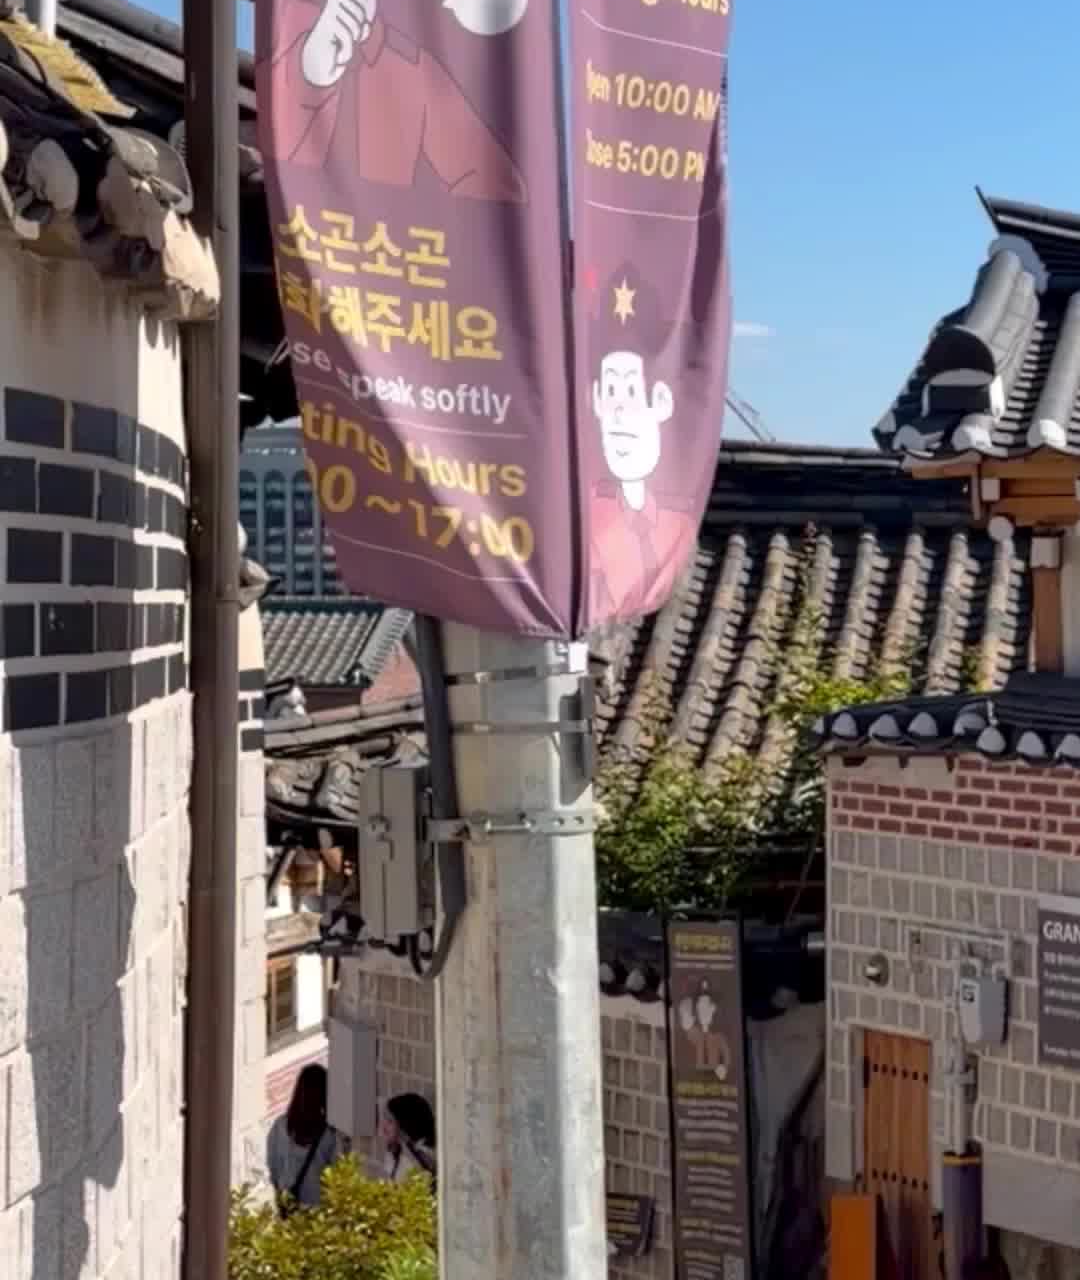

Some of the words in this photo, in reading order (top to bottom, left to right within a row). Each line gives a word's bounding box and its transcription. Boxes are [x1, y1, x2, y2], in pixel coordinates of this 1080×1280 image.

[615, 73, 690, 116] 10:00
[616, 141, 679, 179] 5:00
[279, 204, 450, 289] 소곤소곤
[276, 260, 503, 361] 화해주세요
[421, 383, 511, 425] softly
[404, 440, 527, 498] Hours
